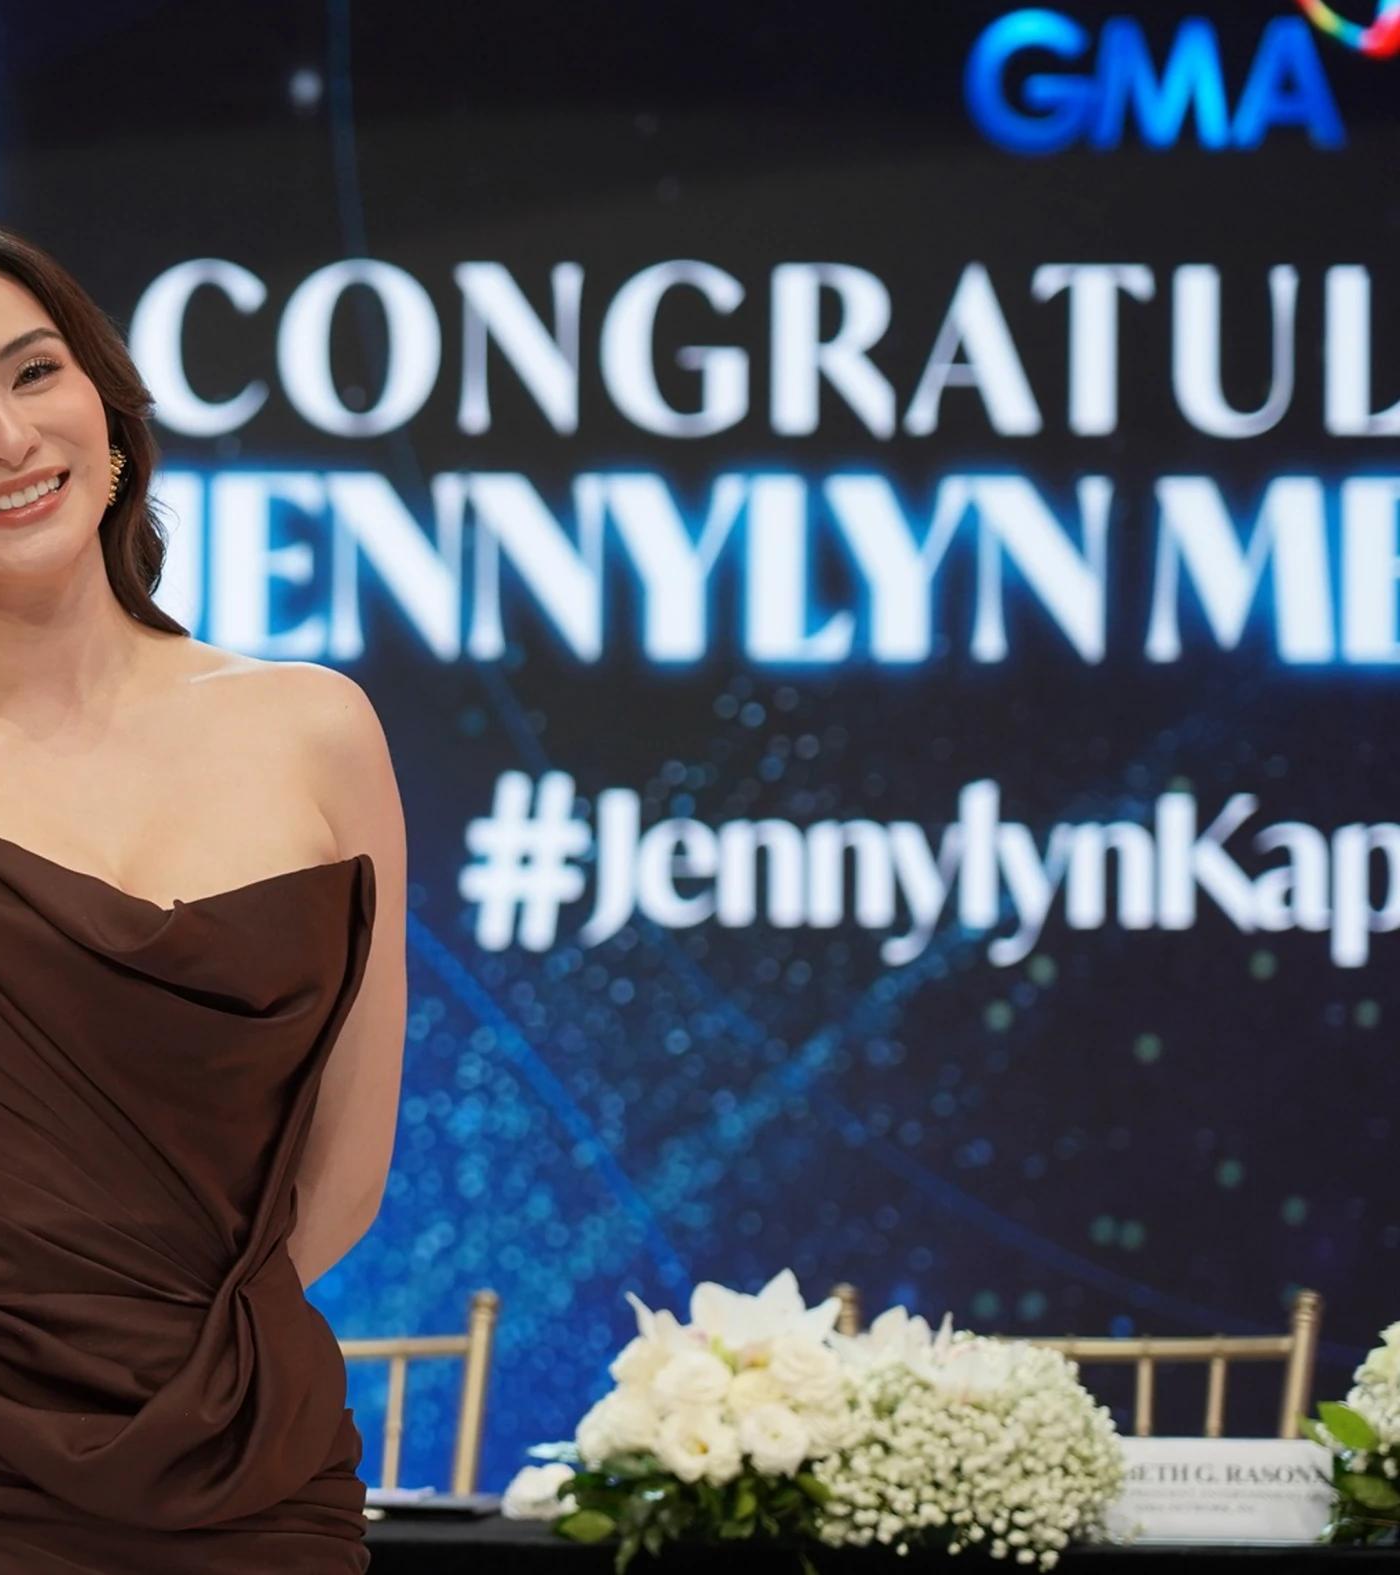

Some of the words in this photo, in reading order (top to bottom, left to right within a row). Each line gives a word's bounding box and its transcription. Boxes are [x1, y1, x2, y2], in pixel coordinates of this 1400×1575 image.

[963, 8, 1346, 155] GMA
[128, 257, 1400, 440] CONGRATUL
[458, 770, 1400, 968] #JennylynKap
